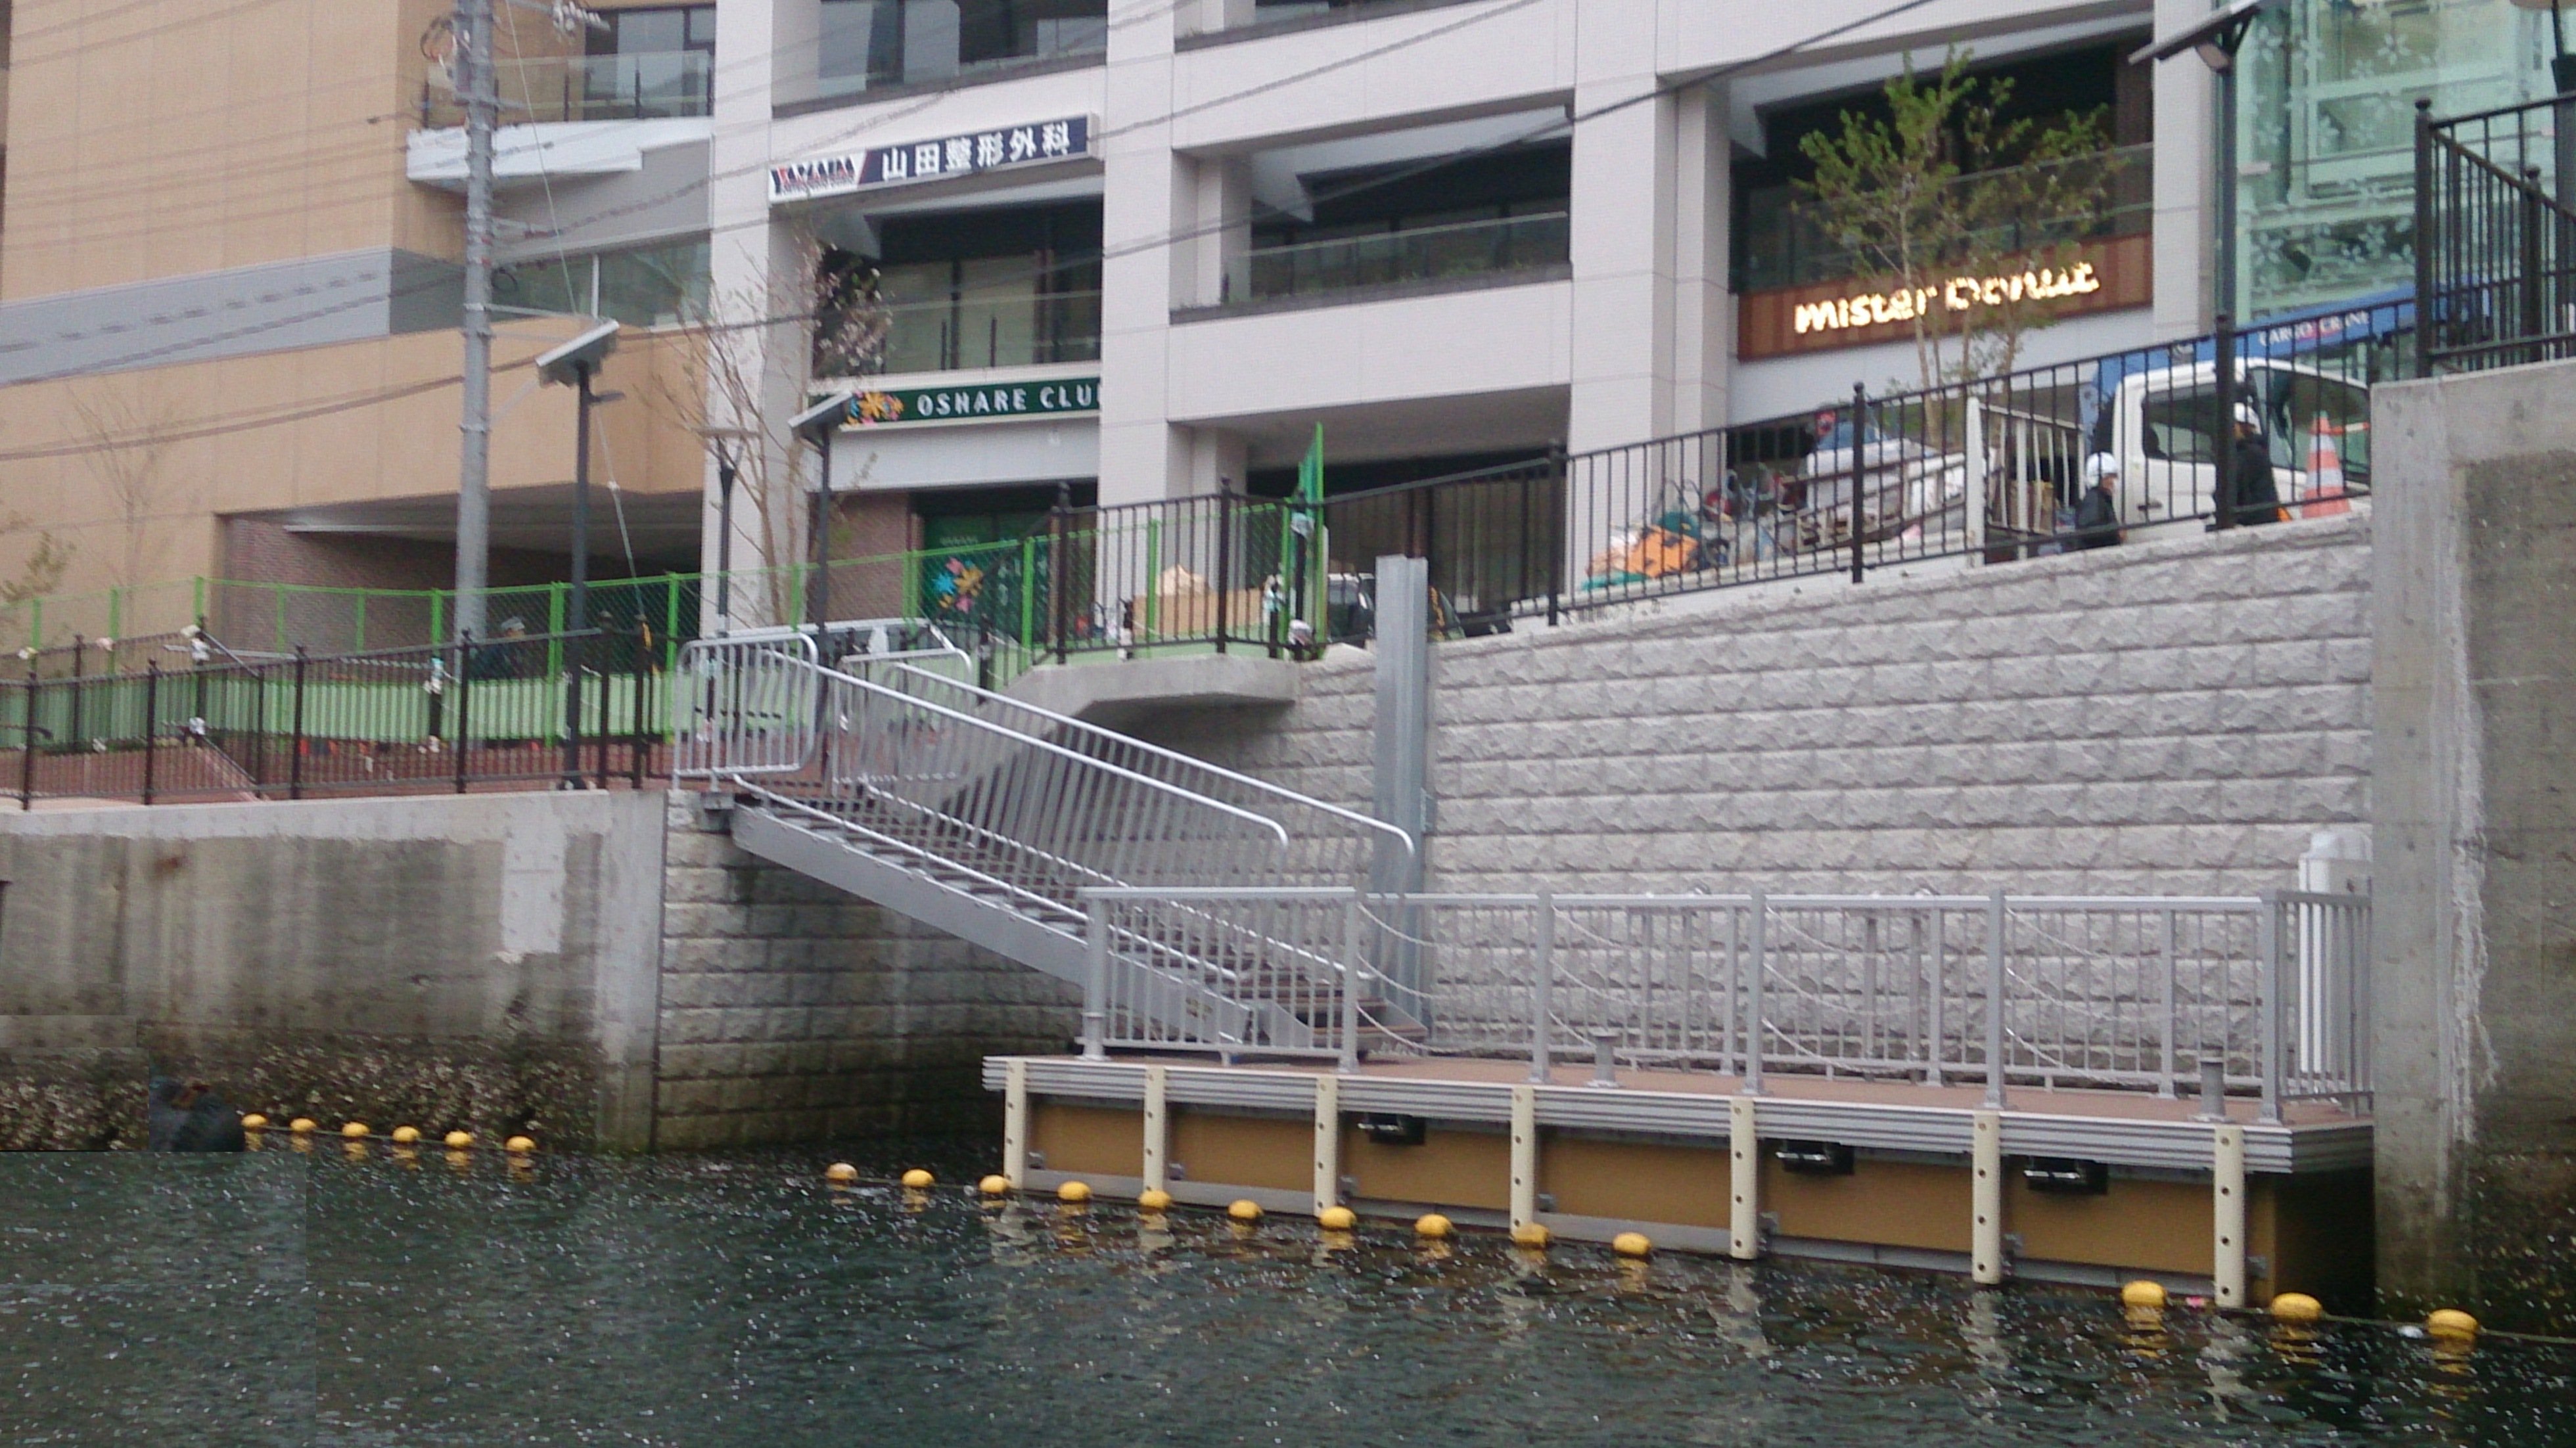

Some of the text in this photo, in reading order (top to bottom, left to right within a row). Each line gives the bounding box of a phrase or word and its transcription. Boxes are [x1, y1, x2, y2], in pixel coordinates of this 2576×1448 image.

[883, 121, 1070, 181] 山田整形外科
[917, 384, 1100, 417] OSHARE CLU
